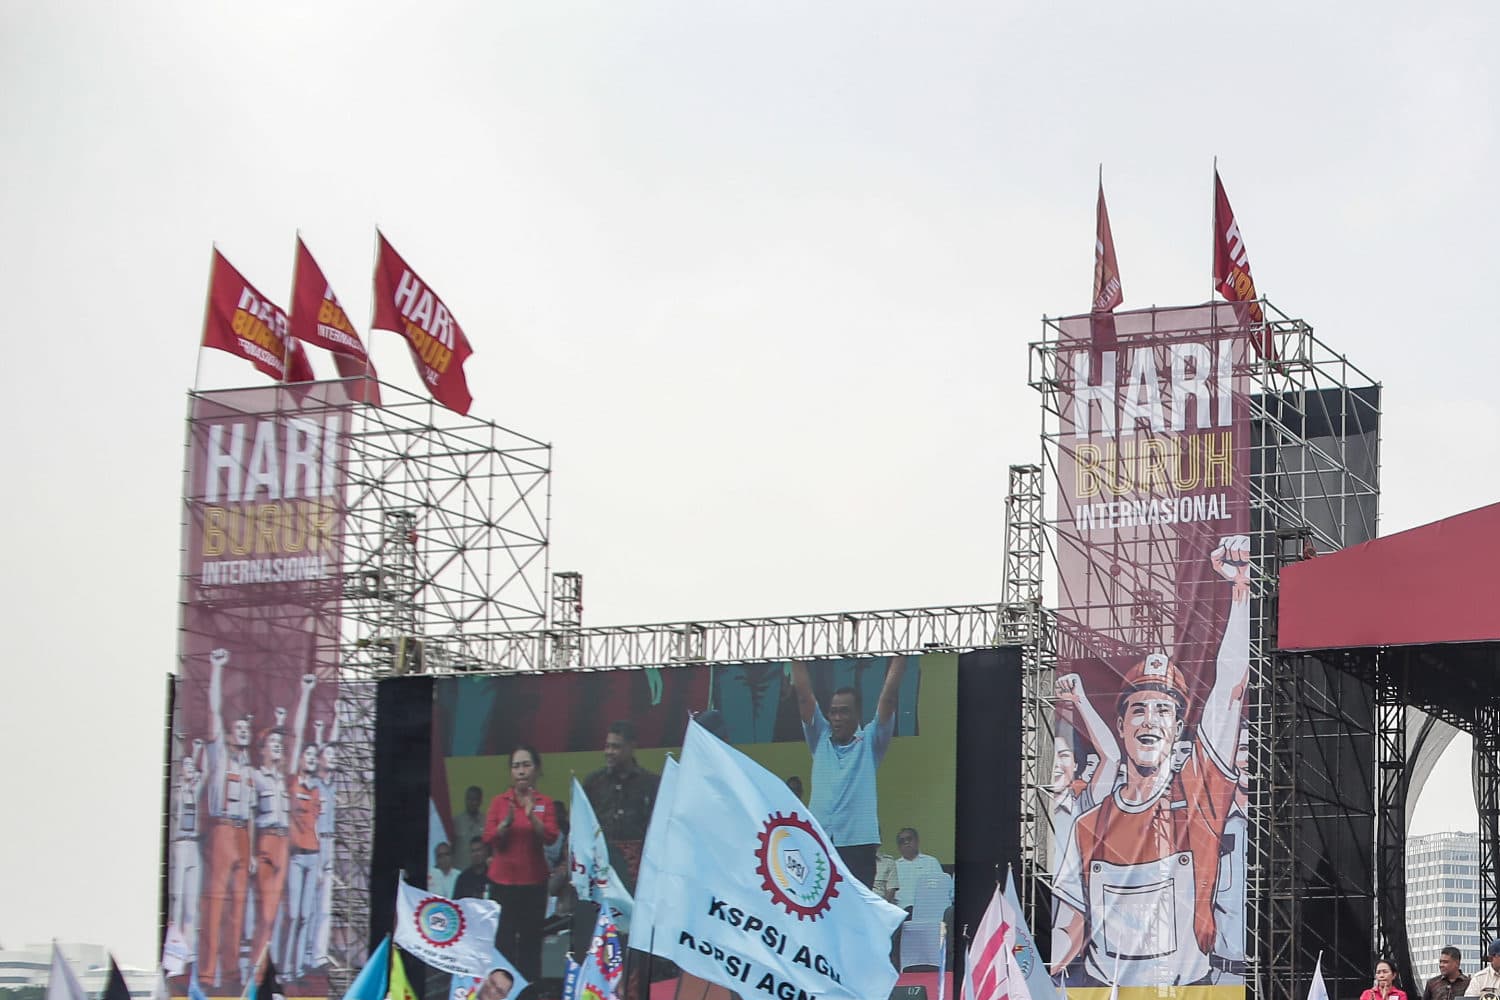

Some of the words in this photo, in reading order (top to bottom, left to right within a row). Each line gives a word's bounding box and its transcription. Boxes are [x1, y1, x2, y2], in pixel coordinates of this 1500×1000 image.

[394, 270, 455, 350] HARI
[1073, 339, 1234, 438] HARI
[205, 417, 340, 500] HARI
[1075, 432, 1232, 498] BURUH
[201, 499, 333, 556] BURUH
[1076, 494, 1232, 530] INTERNASIONAL
[201, 556, 328, 585] INTERNASIONAL
[708, 897, 787, 955] KSPSI
